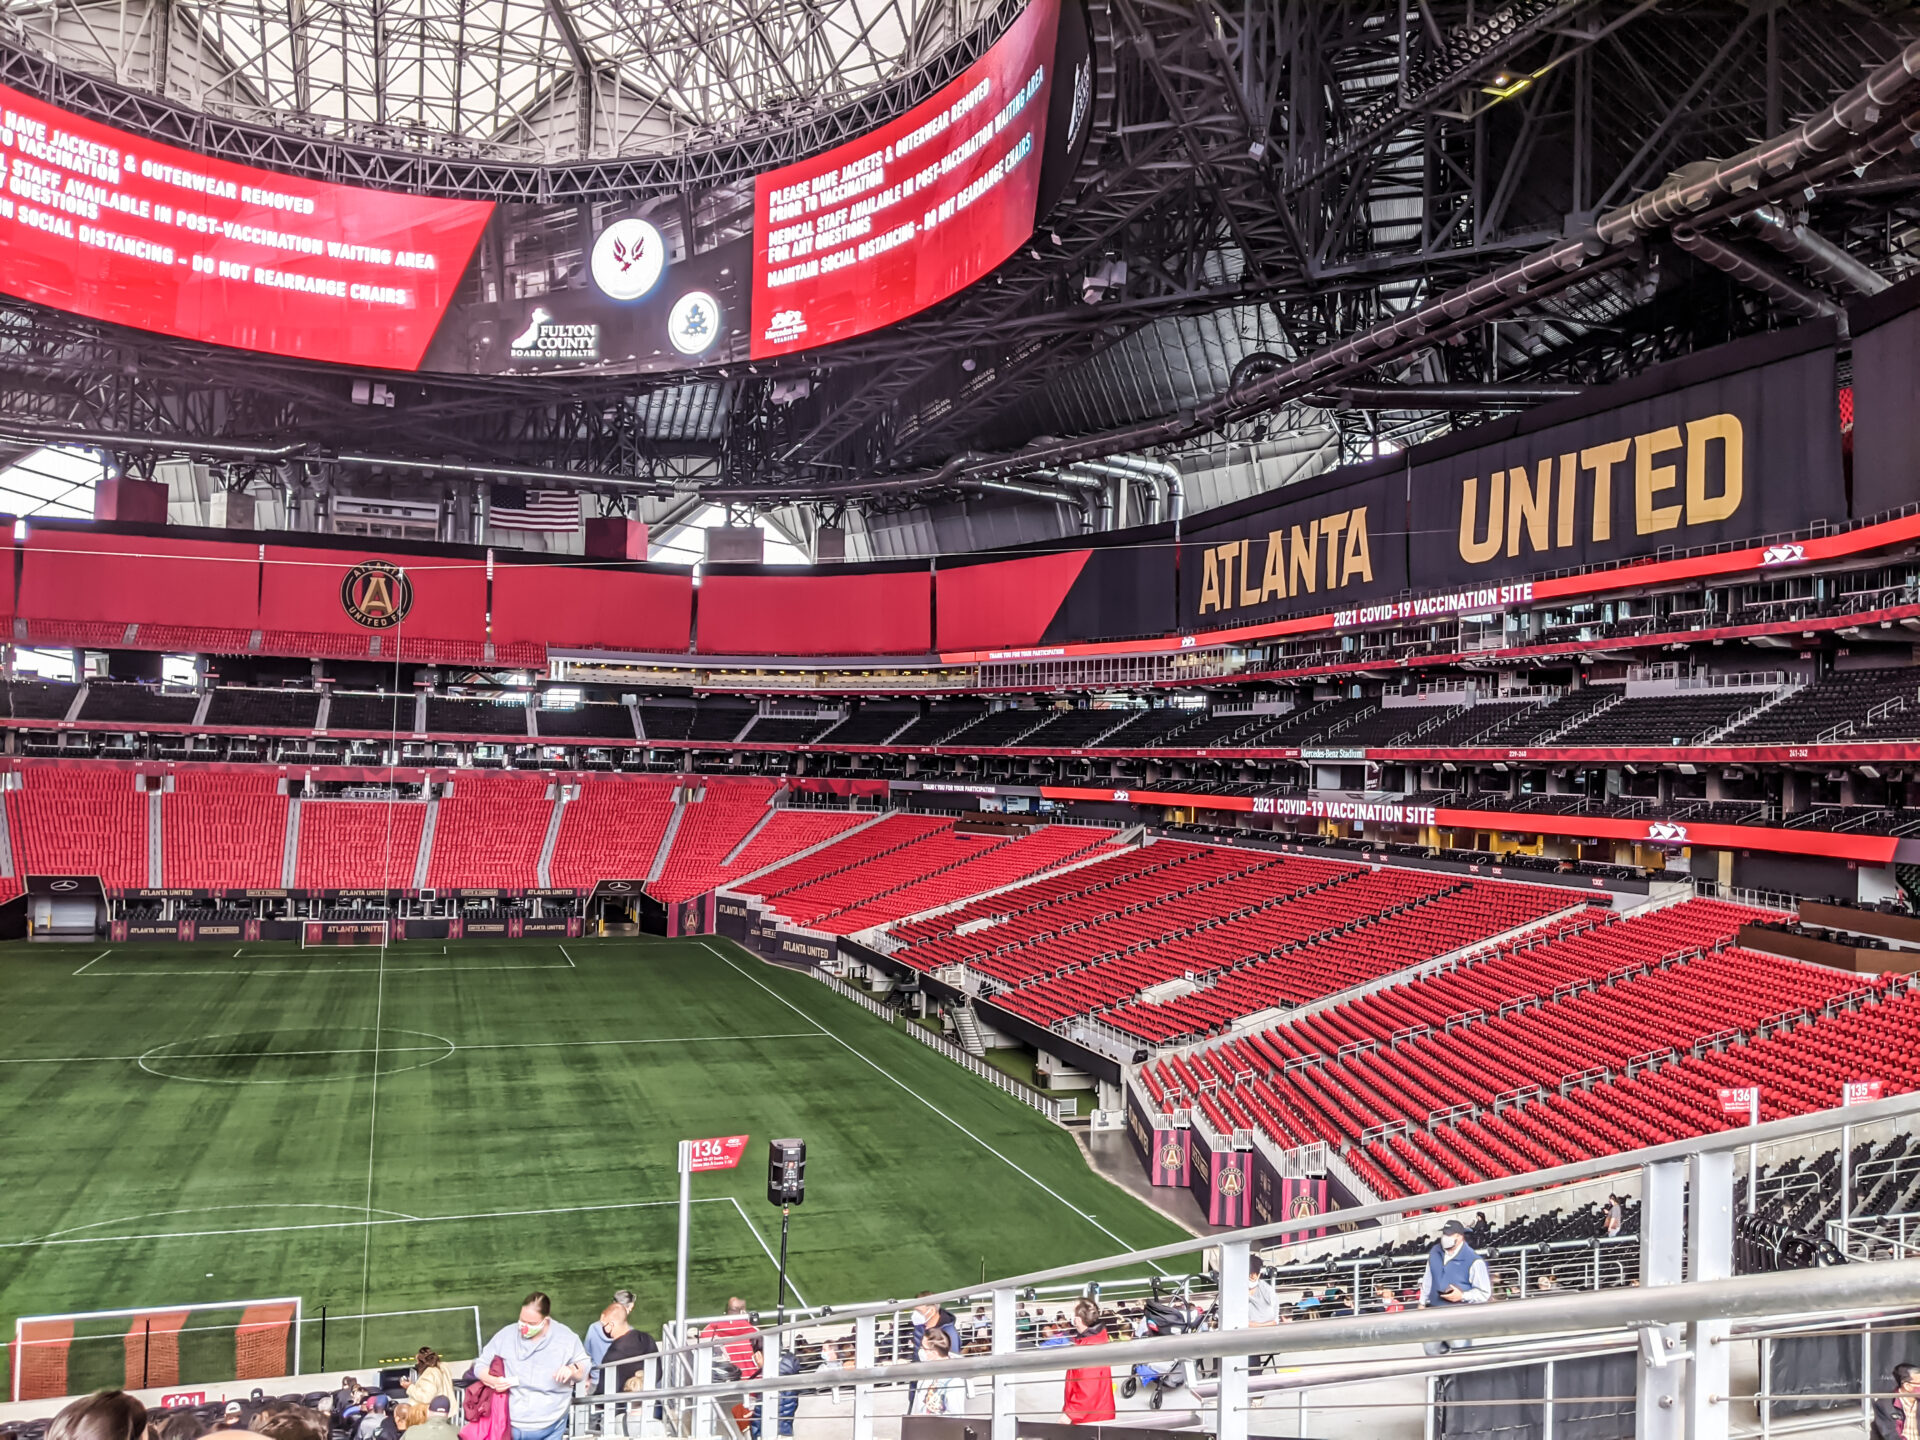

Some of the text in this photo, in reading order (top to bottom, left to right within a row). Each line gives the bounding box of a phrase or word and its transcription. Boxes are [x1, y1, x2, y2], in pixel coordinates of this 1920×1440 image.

[6, 110, 46, 142] HAVE
[50, 130, 119, 167] JACKETS
[124, 154, 136, 173] &
[141, 160, 236, 199] OUTERWEAR
[241, 186, 314, 214] REMOVED
[17, 133, 120, 185] VACCINATION
[768, 64, 1044, 247] MEDICAL STAFF AVAILABLE IN POST-VACCINATION WAITING AREA
[769, 77, 990, 207] PLEASE HAVE JACKETS & OUTERWEAR REMOVED
[10, 176, 98, 220] QUESTIONS
[12, 158, 61, 189] STAFF
[65, 178, 149, 218] AVAILABLE
[154, 204, 172, 224] IN
[176, 210, 323, 255] POST-VACCINATION
[327, 241, 391, 265] WAITING
[395, 251, 435, 270] AREA
[768, 260, 818, 288] MAINTAIN
[820, 248, 856, 274] SOCIAL
[858, 221, 915, 260] DISTANCING
[924, 208, 936, 231] DO
[938, 196, 956, 222] NOT
[957, 159, 1004, 210] REARRANGE
[1004, 132, 1032, 173] CHAIRS
[769, 167, 884, 223] PRIOR TO VACCINATION
[18, 205, 74, 239] SOCIAL
[79, 224, 173, 265] DISTANCING
[192, 254, 215, 273] DO
[219, 261, 250, 281] NOT
[254, 268, 346, 297] REARRANGE
[350, 283, 406, 304] CHAIRS
[768, 216, 871, 264] FOR ANY QUESTIONS
[537, 336, 595, 349] COUNTY
[540, 324, 596, 336] FULTON
[1458, 412, 1744, 564] UNITED
[1199, 506, 1374, 615] ATLANTA
[348, 606, 388, 626] UNITED
[1334, 582, 1533, 627] 2021 COVID-19 VACCINATION SITE
[1301, 748, 1338, 758] Mercedes-Benz
[1340, 748, 1362, 758] Stadium
[1252, 798, 1436, 825] 2021 COVID-19 VACCINATION SITE
[718, 904, 738, 916] ATLANTA
[782, 940, 828, 959] ATLANTA UNITED
[1732, 1089, 1750, 1102] 136
[1850, 1083, 1868, 1096] 135
[692, 1140, 722, 1158] 136
